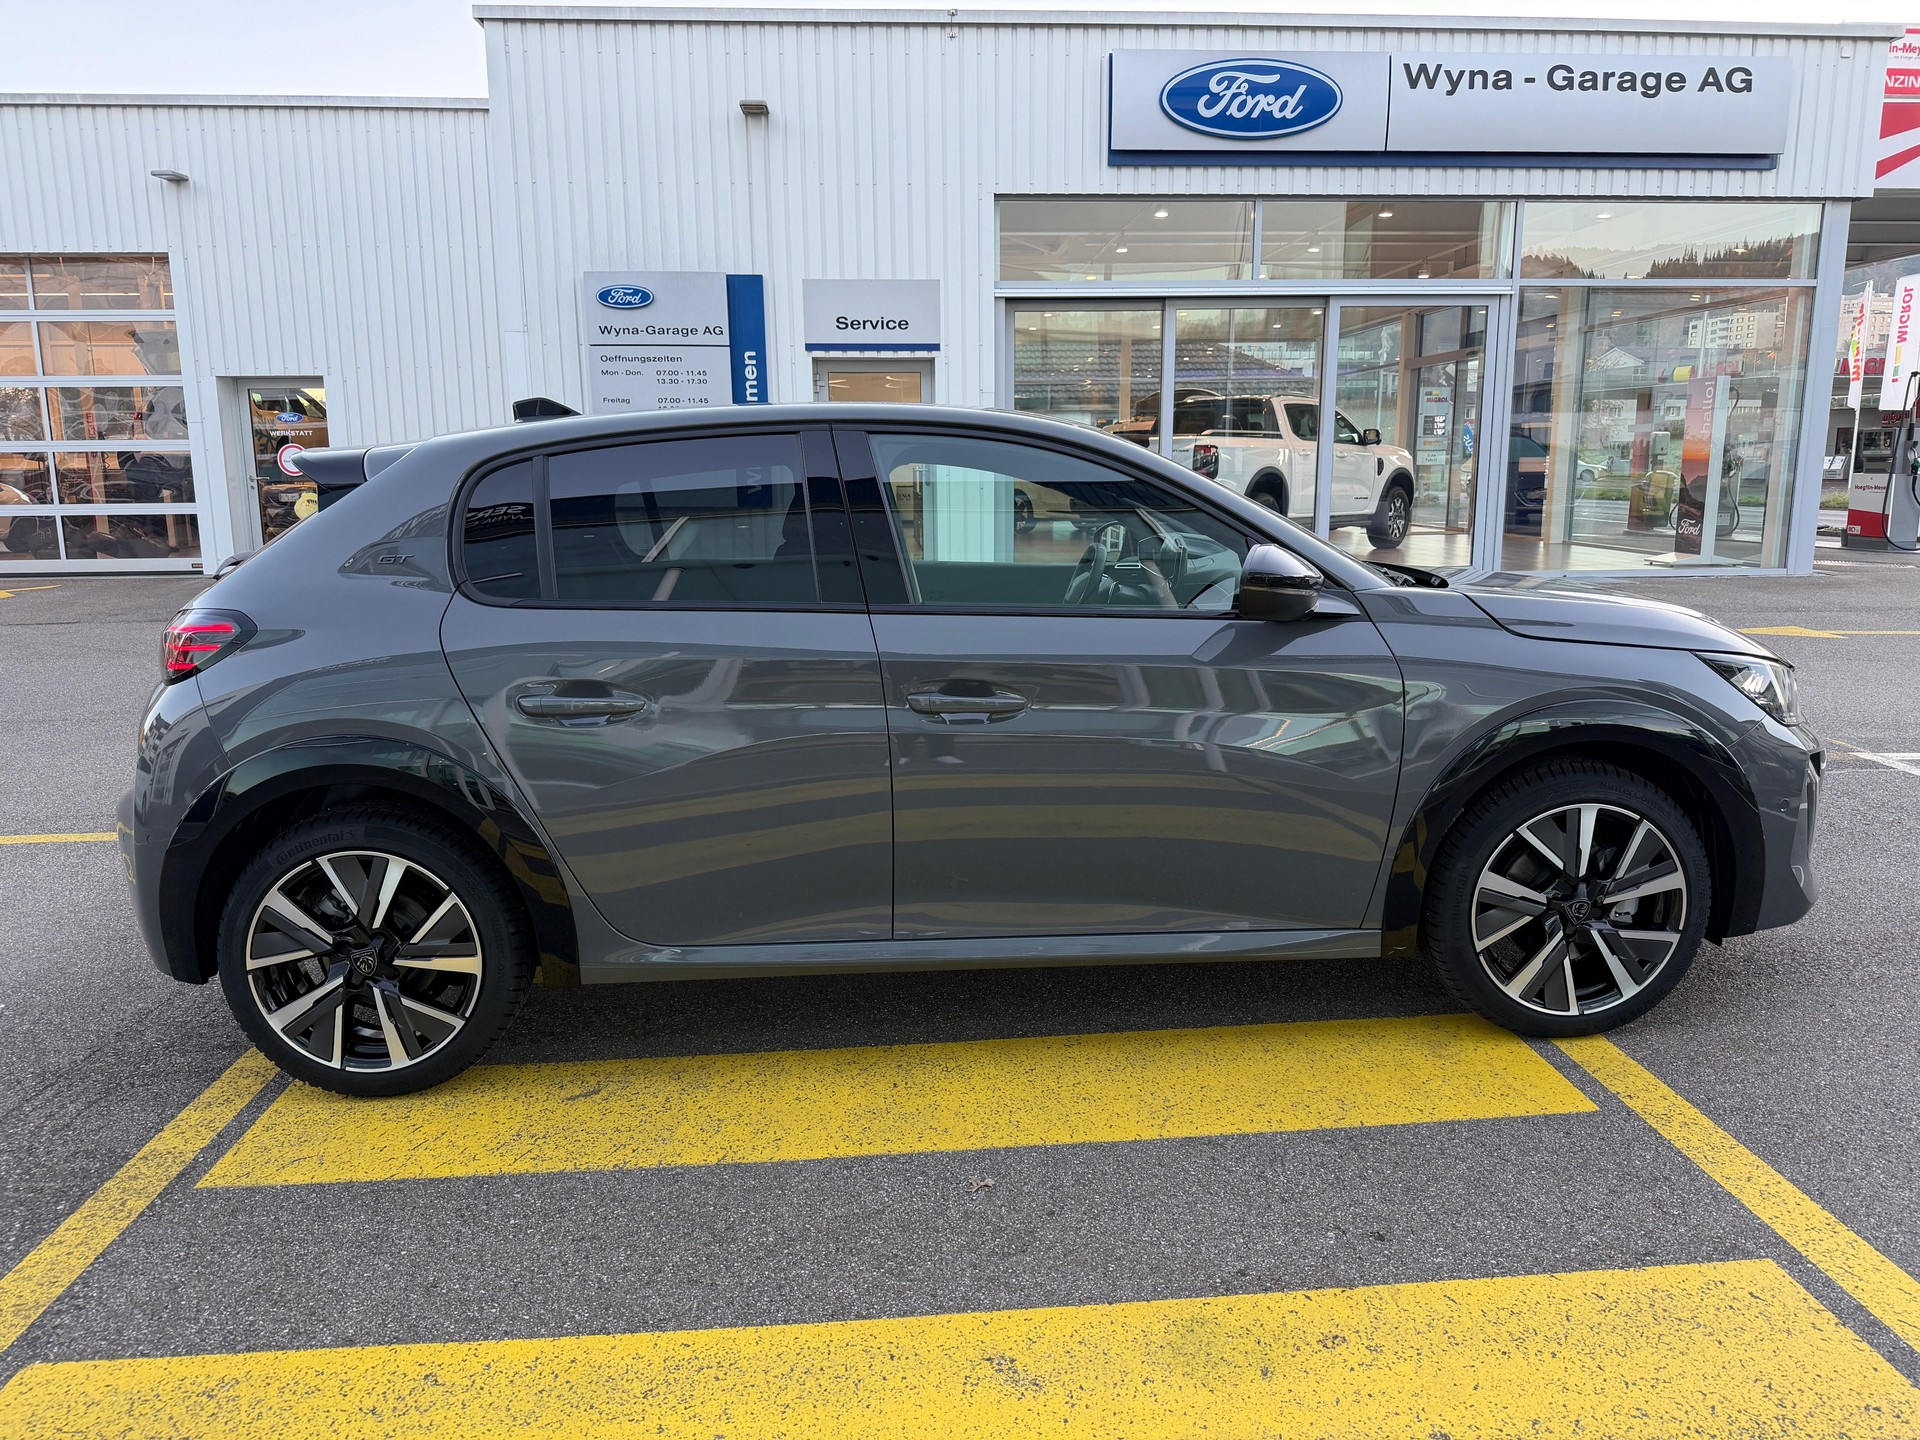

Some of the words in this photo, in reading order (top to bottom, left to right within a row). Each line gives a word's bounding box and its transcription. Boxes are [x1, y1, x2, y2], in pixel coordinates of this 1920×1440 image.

[1402, 63, 1513, 96] Wyna
[1546, 64, 1687, 98] Garage
[1697, 67, 1754, 93] AG
[1197, 71, 1307, 119] Ford
[608, 288, 642, 303] Ford
[598, 325, 699, 337] Wyna-Garage
[702, 325, 724, 336] AG
[835, 316, 909, 331] Service
[600, 355, 683, 364] Oeffnungszeiten
[1678, 518, 1702, 535] Ford
[377, 555, 415, 564] GT
